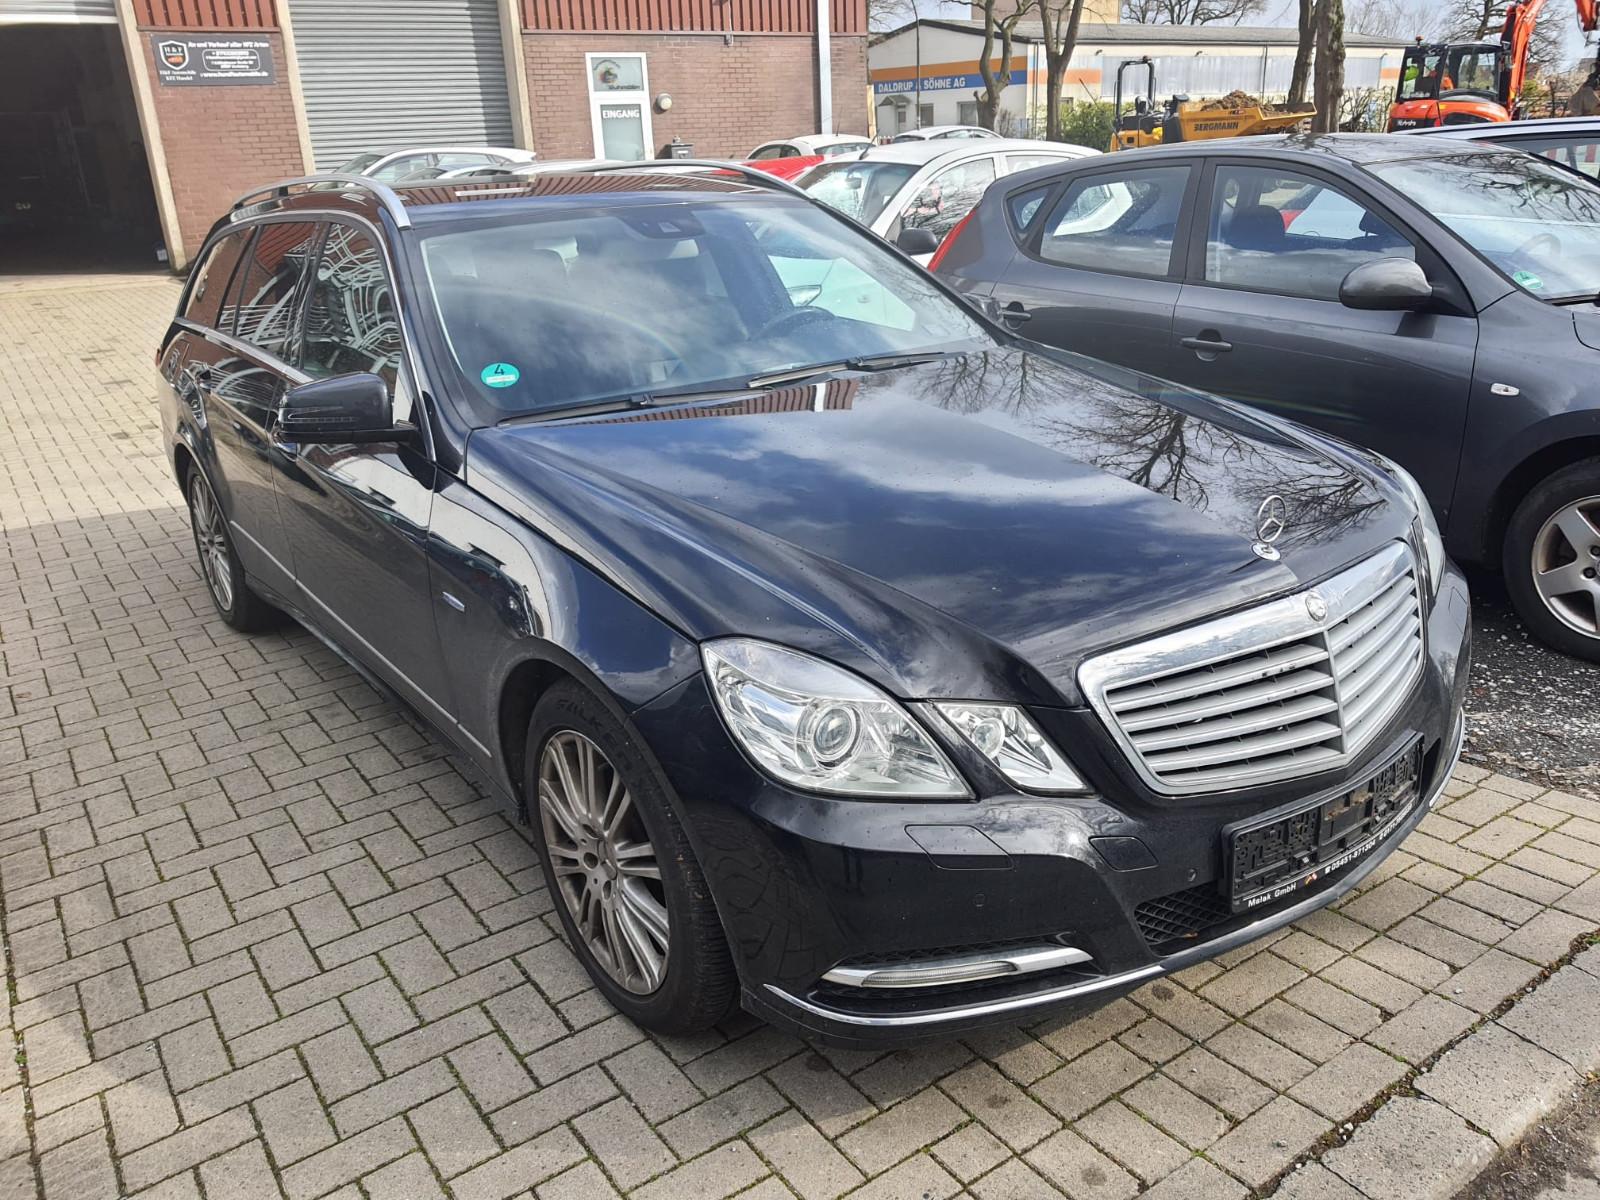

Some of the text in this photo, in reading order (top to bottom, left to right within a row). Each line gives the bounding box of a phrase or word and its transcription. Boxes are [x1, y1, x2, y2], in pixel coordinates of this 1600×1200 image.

[878, 81, 913, 93] DALDRUP
[923, 77, 951, 90] SÖHNE
[953, 77, 966, 88] AG
[602, 109, 640, 119] EINGANG
[1194, 122, 1239, 131] BERGMANN
[494, 364, 505, 375] 4
[1274, 882, 1297, 898] GmbH
